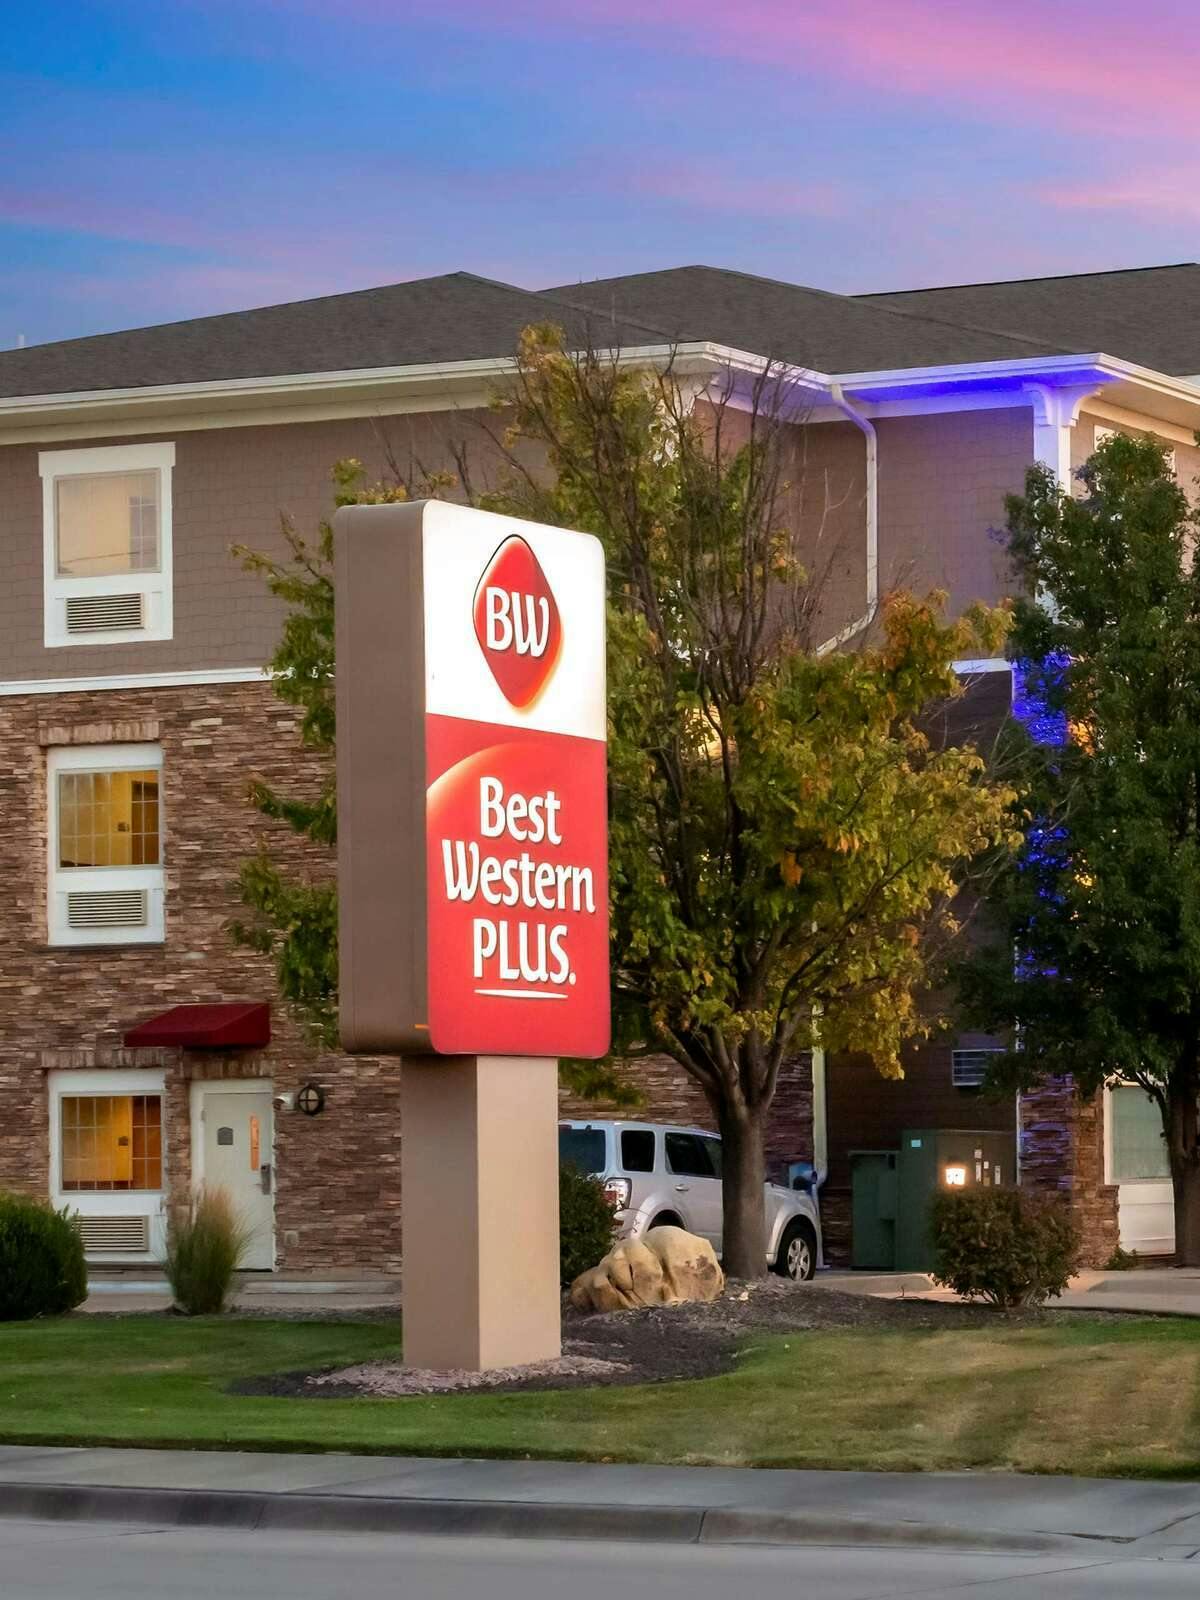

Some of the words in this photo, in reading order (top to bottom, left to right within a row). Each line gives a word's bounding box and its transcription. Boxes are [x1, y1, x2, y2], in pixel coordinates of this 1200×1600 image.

[486, 587, 550, 658] BW
[479, 776, 562, 845] Best
[442, 839, 596, 913] Western
